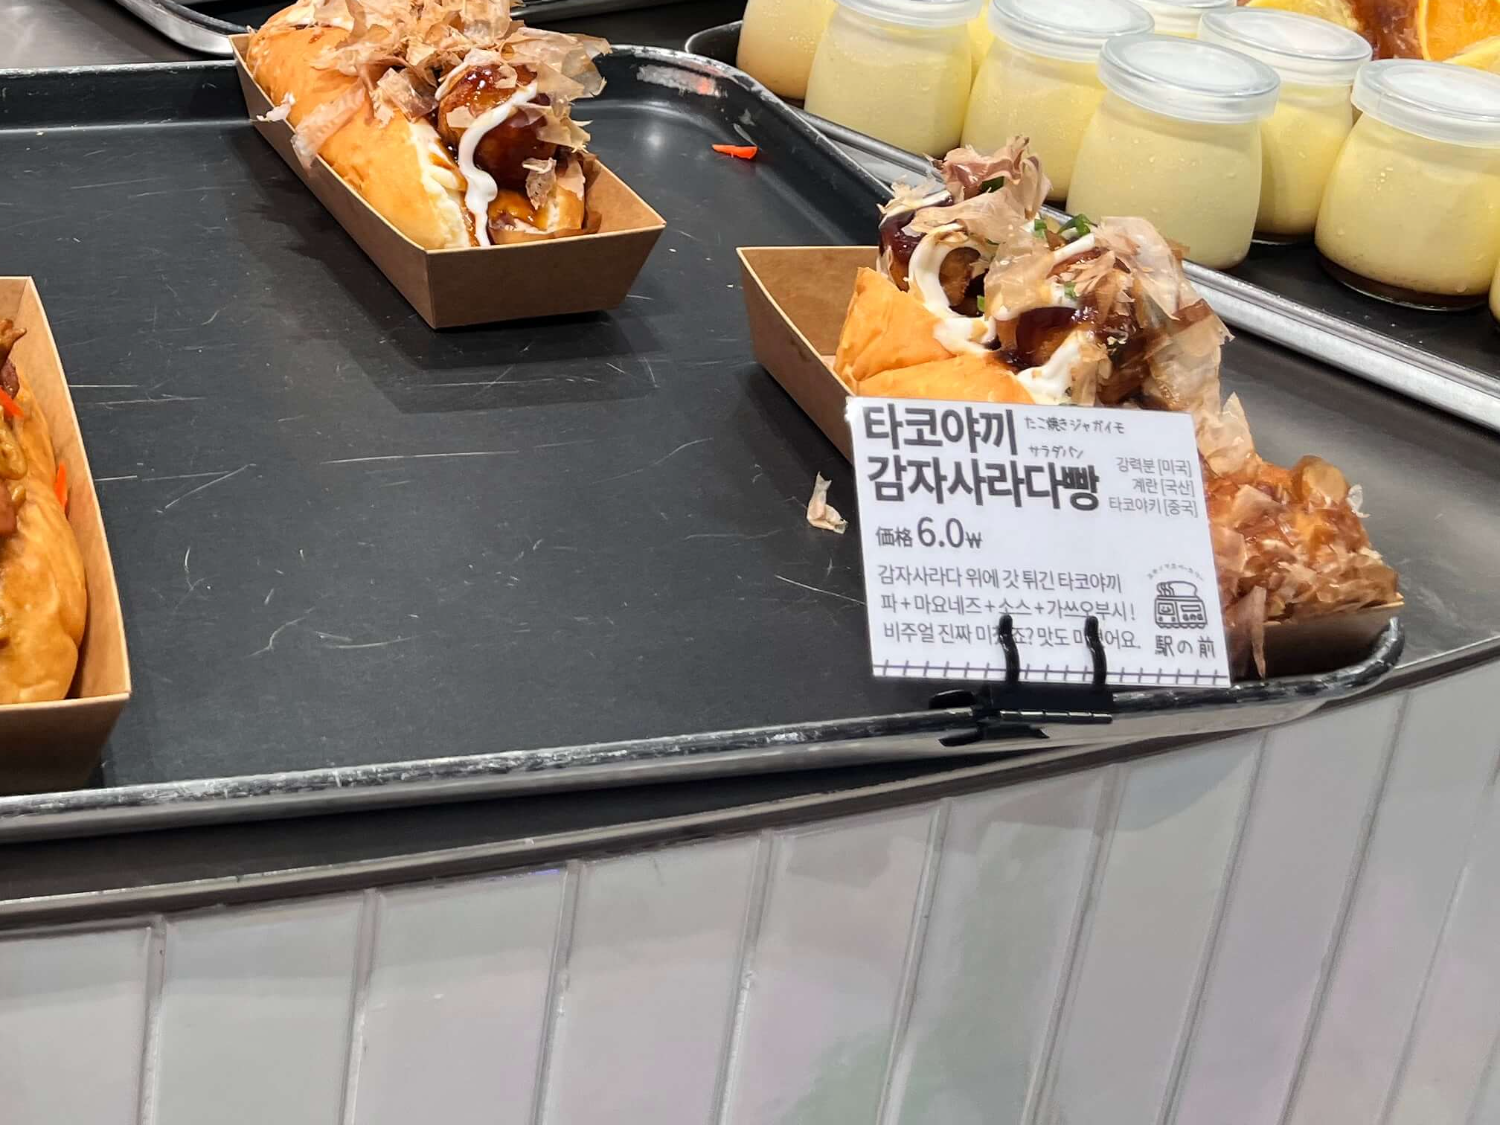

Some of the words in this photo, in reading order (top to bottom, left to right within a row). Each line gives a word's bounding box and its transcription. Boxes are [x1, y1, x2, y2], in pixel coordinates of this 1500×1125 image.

[863, 403, 1018, 456] 타코야끼
[1116, 457, 1155, 474] 강력분
[866, 456, 1100, 512] 감자사라다빵
[1132, 478, 1159, 495] 계란
[1108, 496, 1162, 514] 타코야키
[875, 525, 913, 548] 価格
[877, 563, 962, 588] 감자사라다
[965, 568, 999, 589] 위에
[1002, 569, 1020, 590] 갓
[1022, 570, 1055, 592] 튀긴
[1057, 571, 1123, 594] 타코야끼
[881, 593, 898, 615] 파
[914, 594, 983, 616] 마요네즈
[998, 597, 1033, 616] 소스
[883, 622, 935, 645] 비주얼
[937, 624, 972, 646] 진짜
[1037, 626, 1071, 648] 맛도
[1154, 634, 1216, 659] 駅の前
